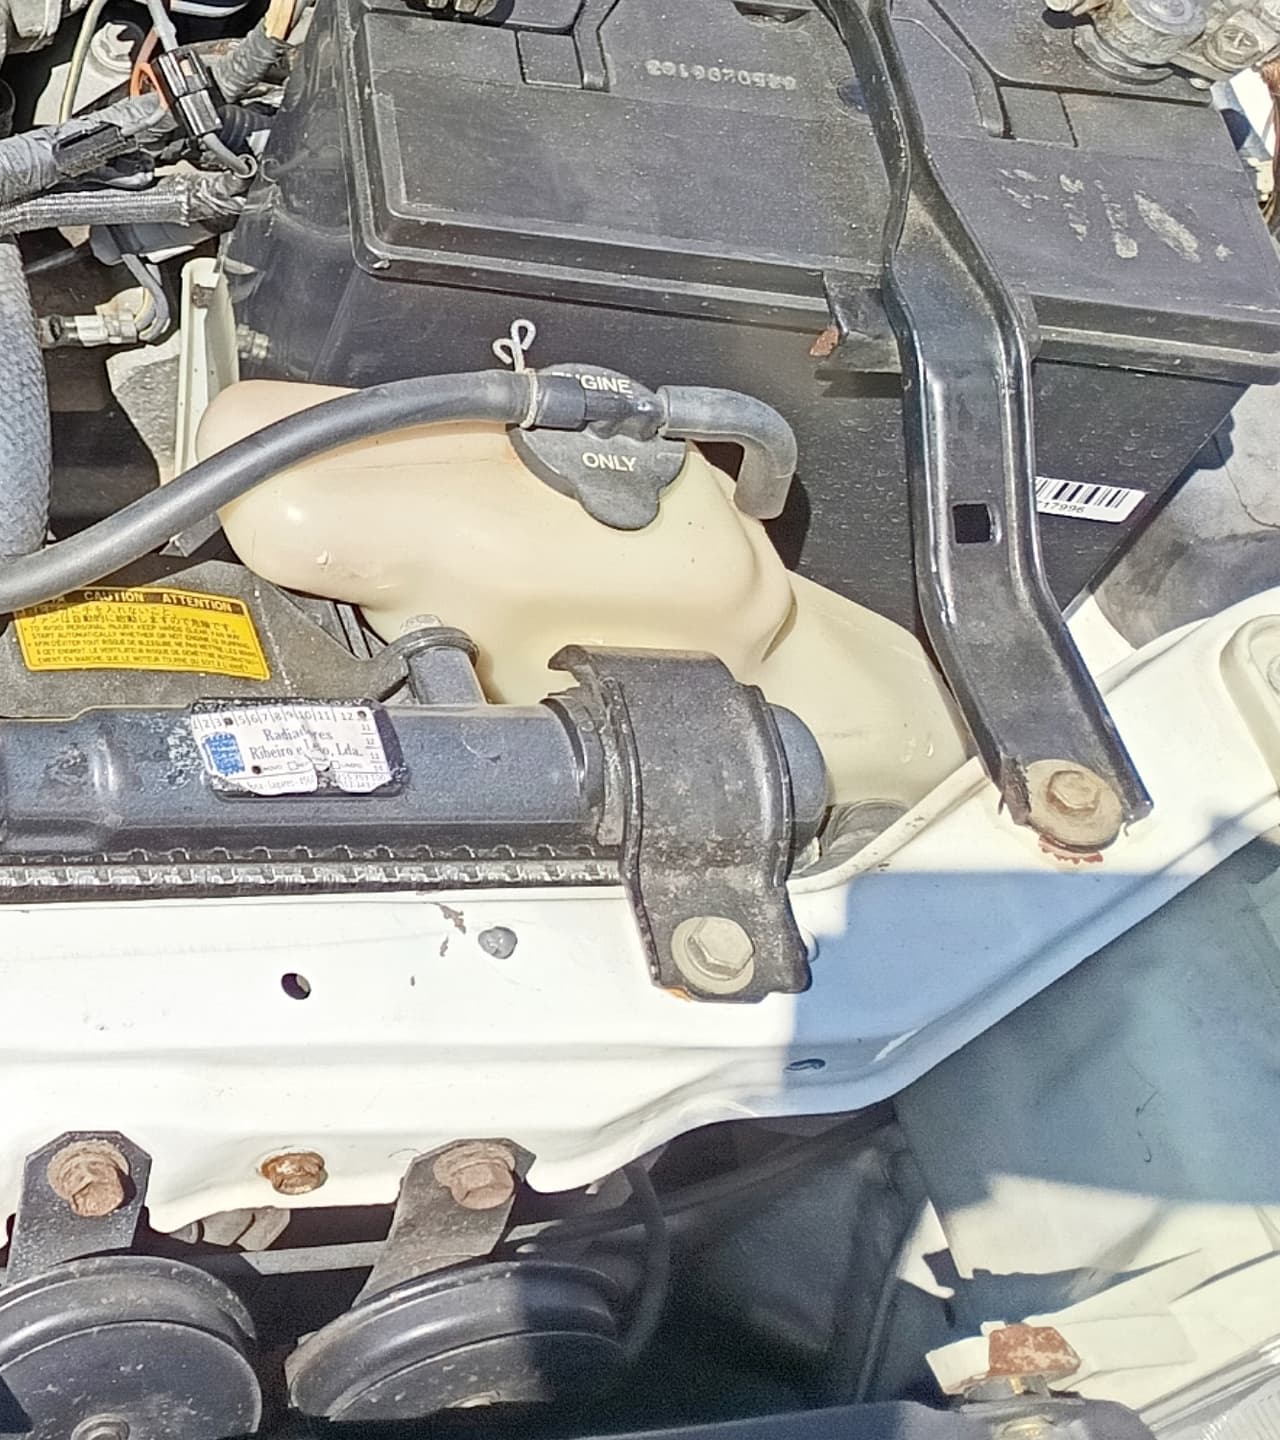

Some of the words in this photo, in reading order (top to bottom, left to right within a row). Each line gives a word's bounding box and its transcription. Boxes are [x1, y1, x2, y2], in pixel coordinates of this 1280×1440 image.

[552, 371, 633, 394] GINE
[582, 452, 637, 472] ONLY
[84, 591, 144, 602] CAUTION
[162, 593, 232, 612] ATTENTION
[341, 711, 353, 721] 12
[249, 744, 294, 760] Ribeiro
